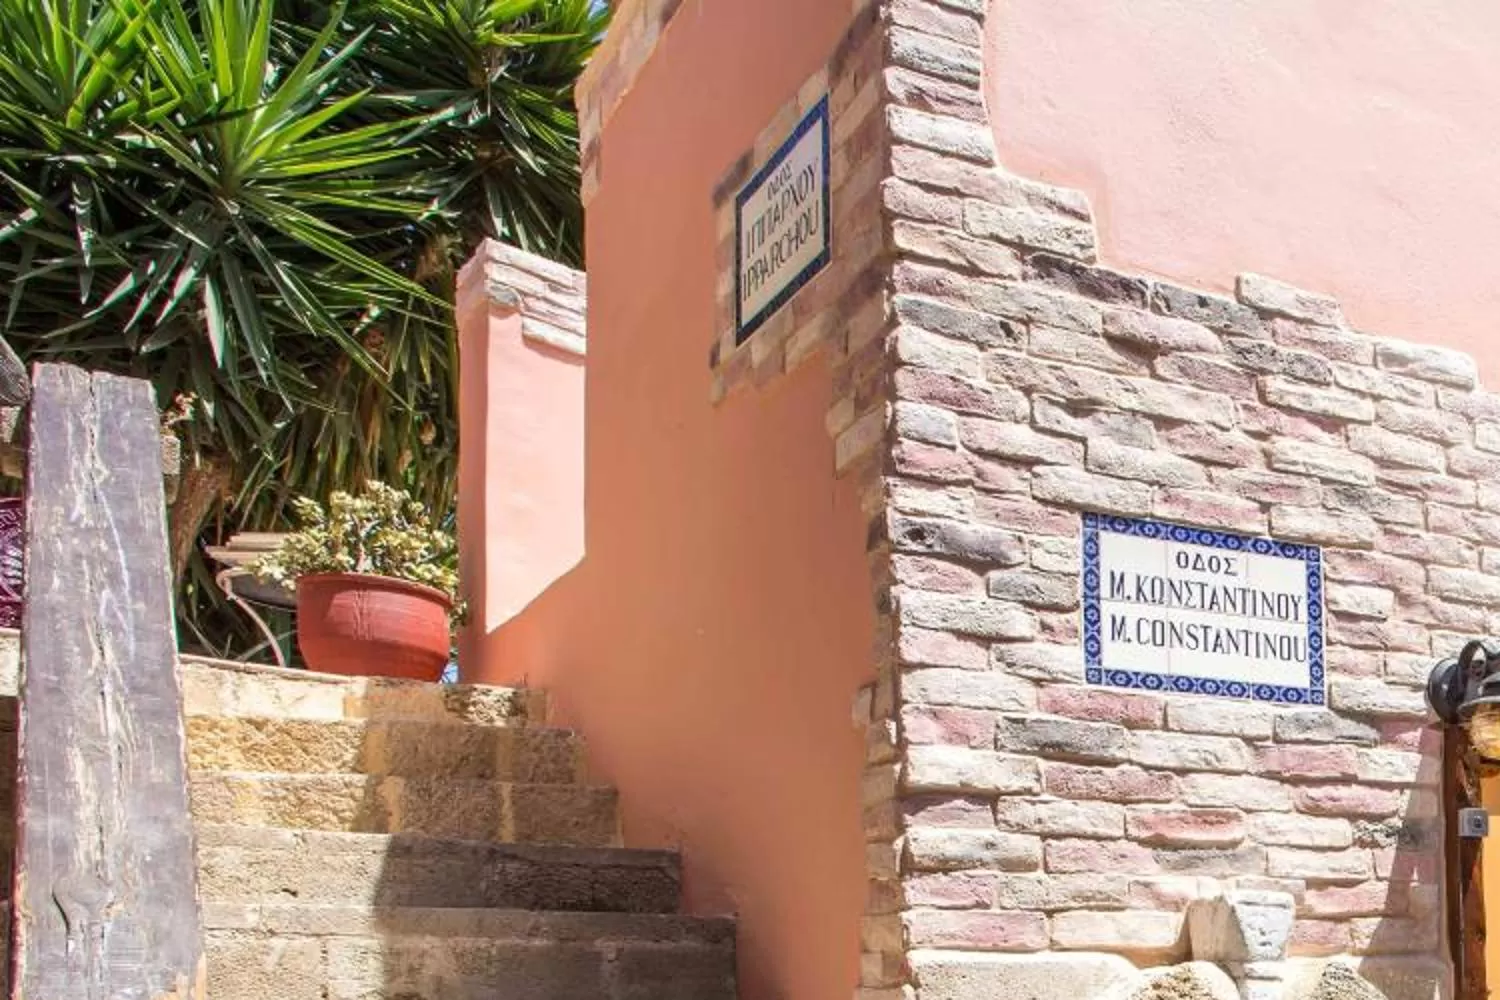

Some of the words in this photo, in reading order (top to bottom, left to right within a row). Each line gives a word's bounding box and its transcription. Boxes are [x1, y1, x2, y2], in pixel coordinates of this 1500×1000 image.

[743, 199, 819, 301] IPPARCHOU
[746, 156, 819, 258] ΙΠΠΑΡΧΟΥ
[1176, 551, 1238, 576] ΟΔΟΣ
